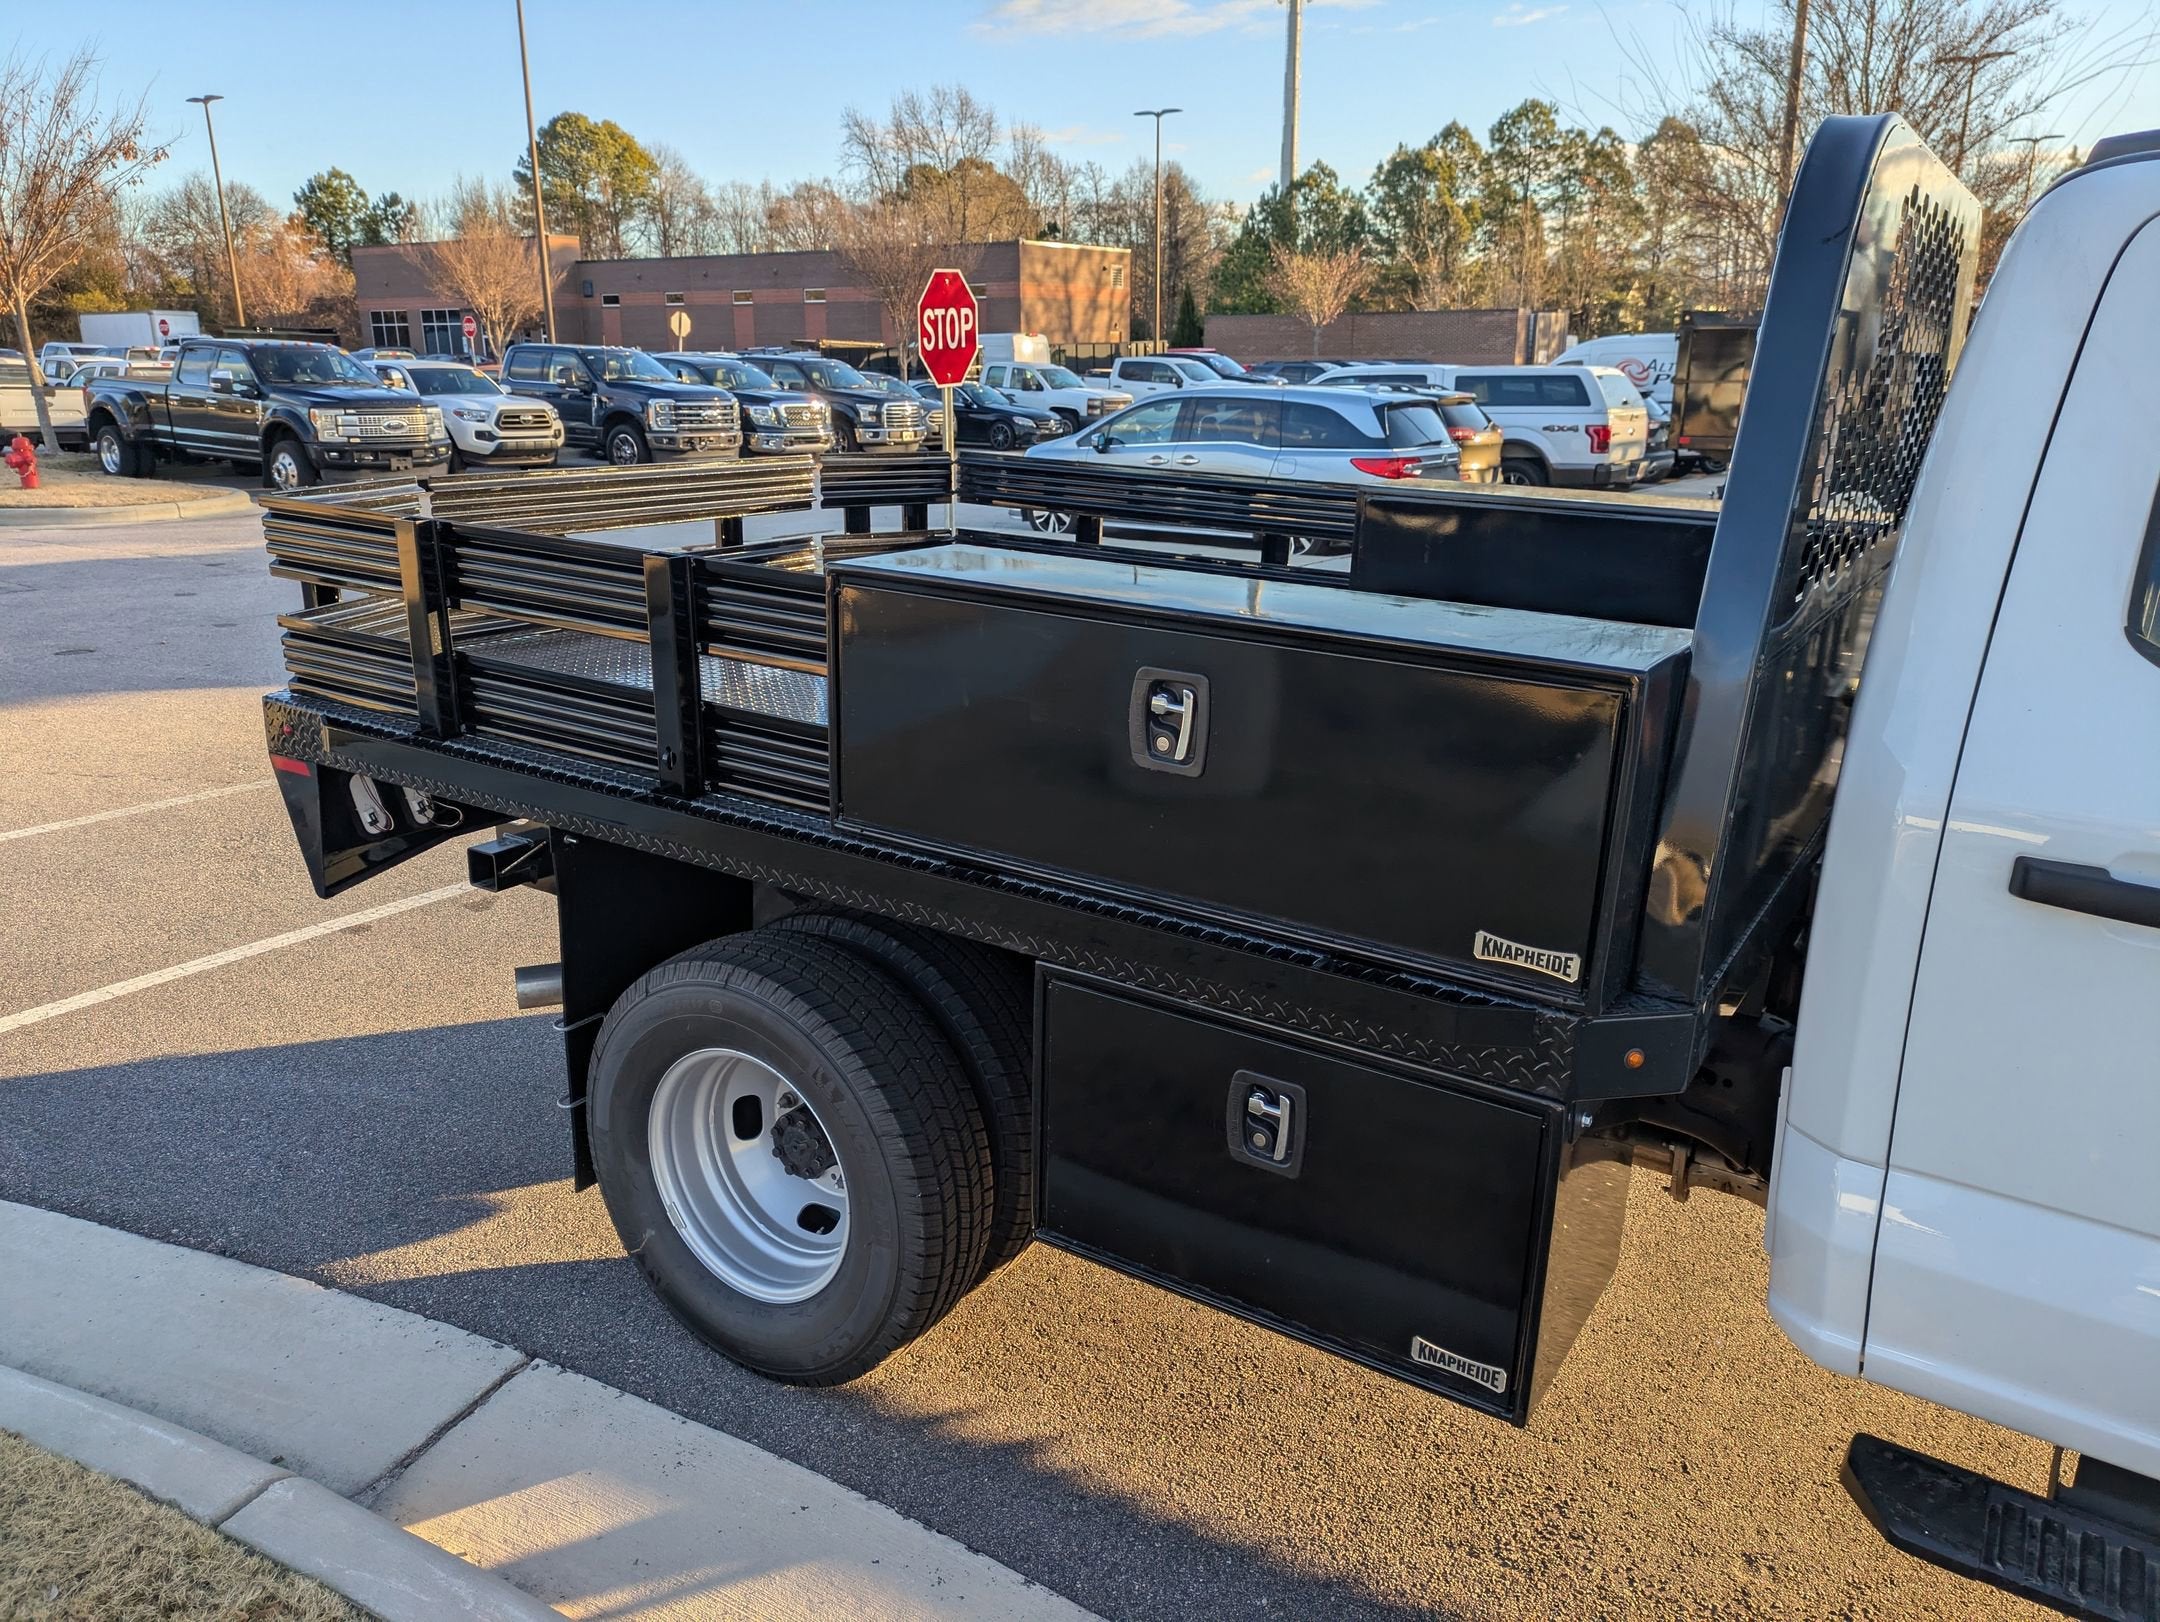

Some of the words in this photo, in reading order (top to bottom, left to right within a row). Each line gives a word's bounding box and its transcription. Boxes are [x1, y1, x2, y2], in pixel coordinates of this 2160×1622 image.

[922, 307, 974, 351] STOP
[1481, 935, 1574, 978] KNAPHEIDE
[1418, 1341, 1501, 1388] KNAPHEIDE
